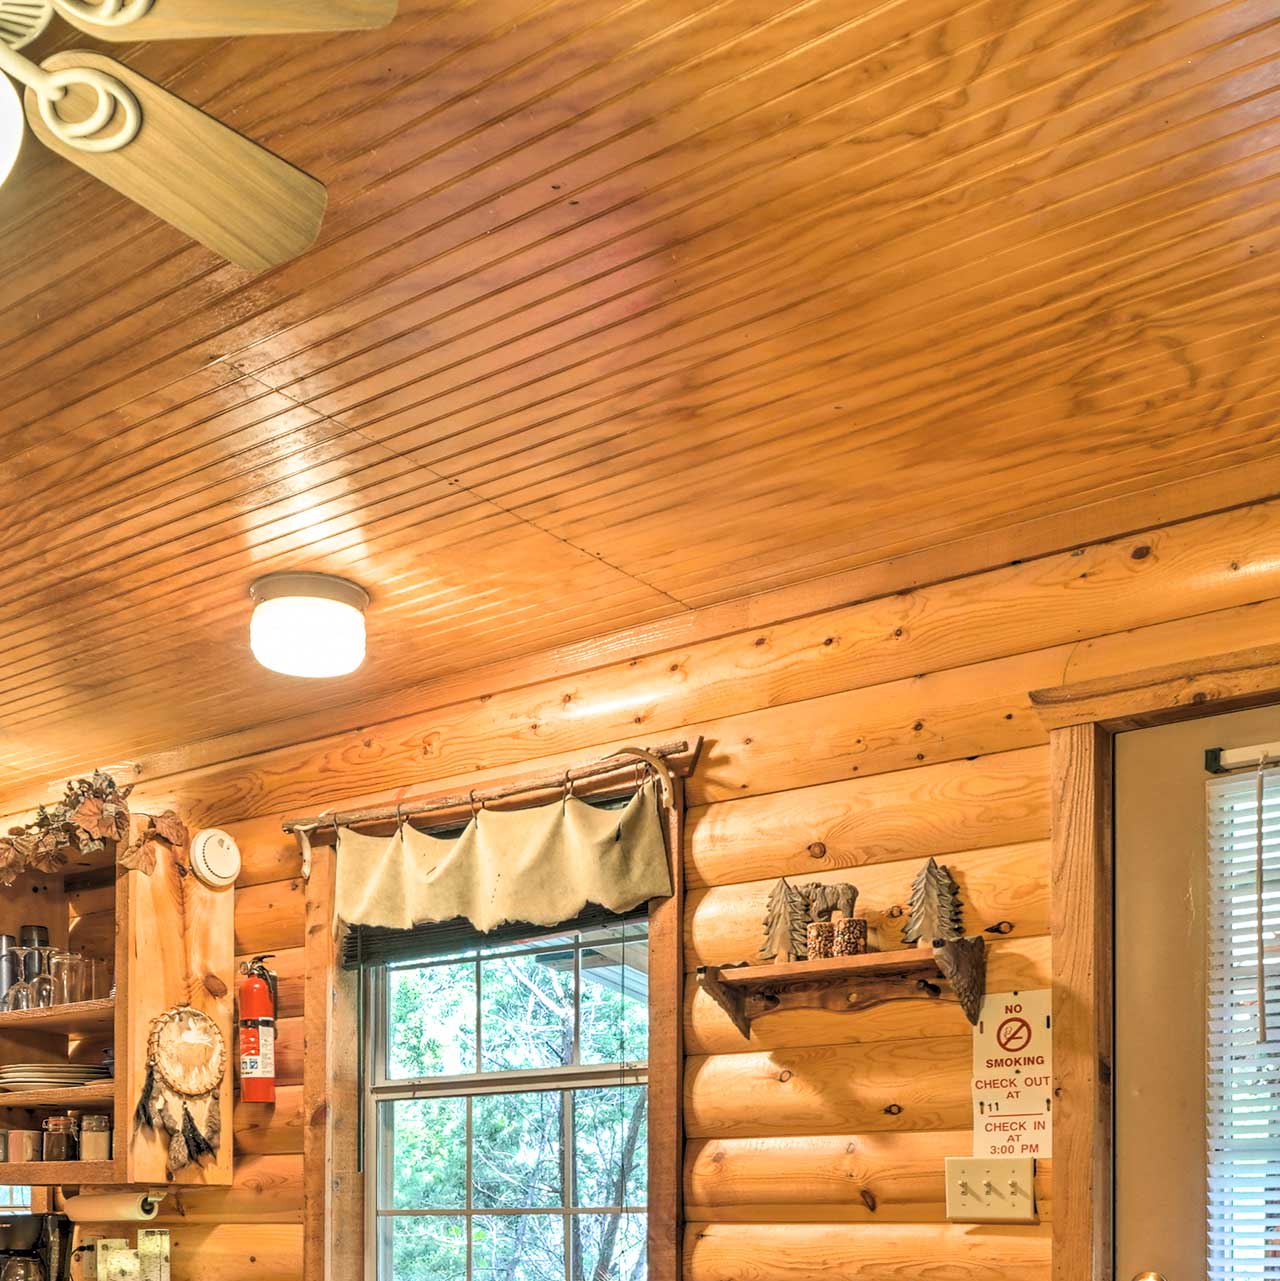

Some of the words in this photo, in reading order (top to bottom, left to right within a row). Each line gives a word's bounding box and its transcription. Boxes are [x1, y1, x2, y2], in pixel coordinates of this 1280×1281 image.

[1005, 1004, 1022, 1014] NO
[986, 1056, 1045, 1069] SMOKING
[975, 1078, 1017, 1090] CHECK
[1024, 1076, 1050, 1087] OUT
[1006, 1091, 1021, 1099] AT
[987, 1102, 999, 1112] 11
[984, 1121, 1027, 1132] CHECK
[1033, 1120, 1046, 1131] IN
[1006, 1134, 1022, 1143] AT
[990, 1145, 1015, 1155] 3:00
[1021, 1144, 1039, 1153] PM
